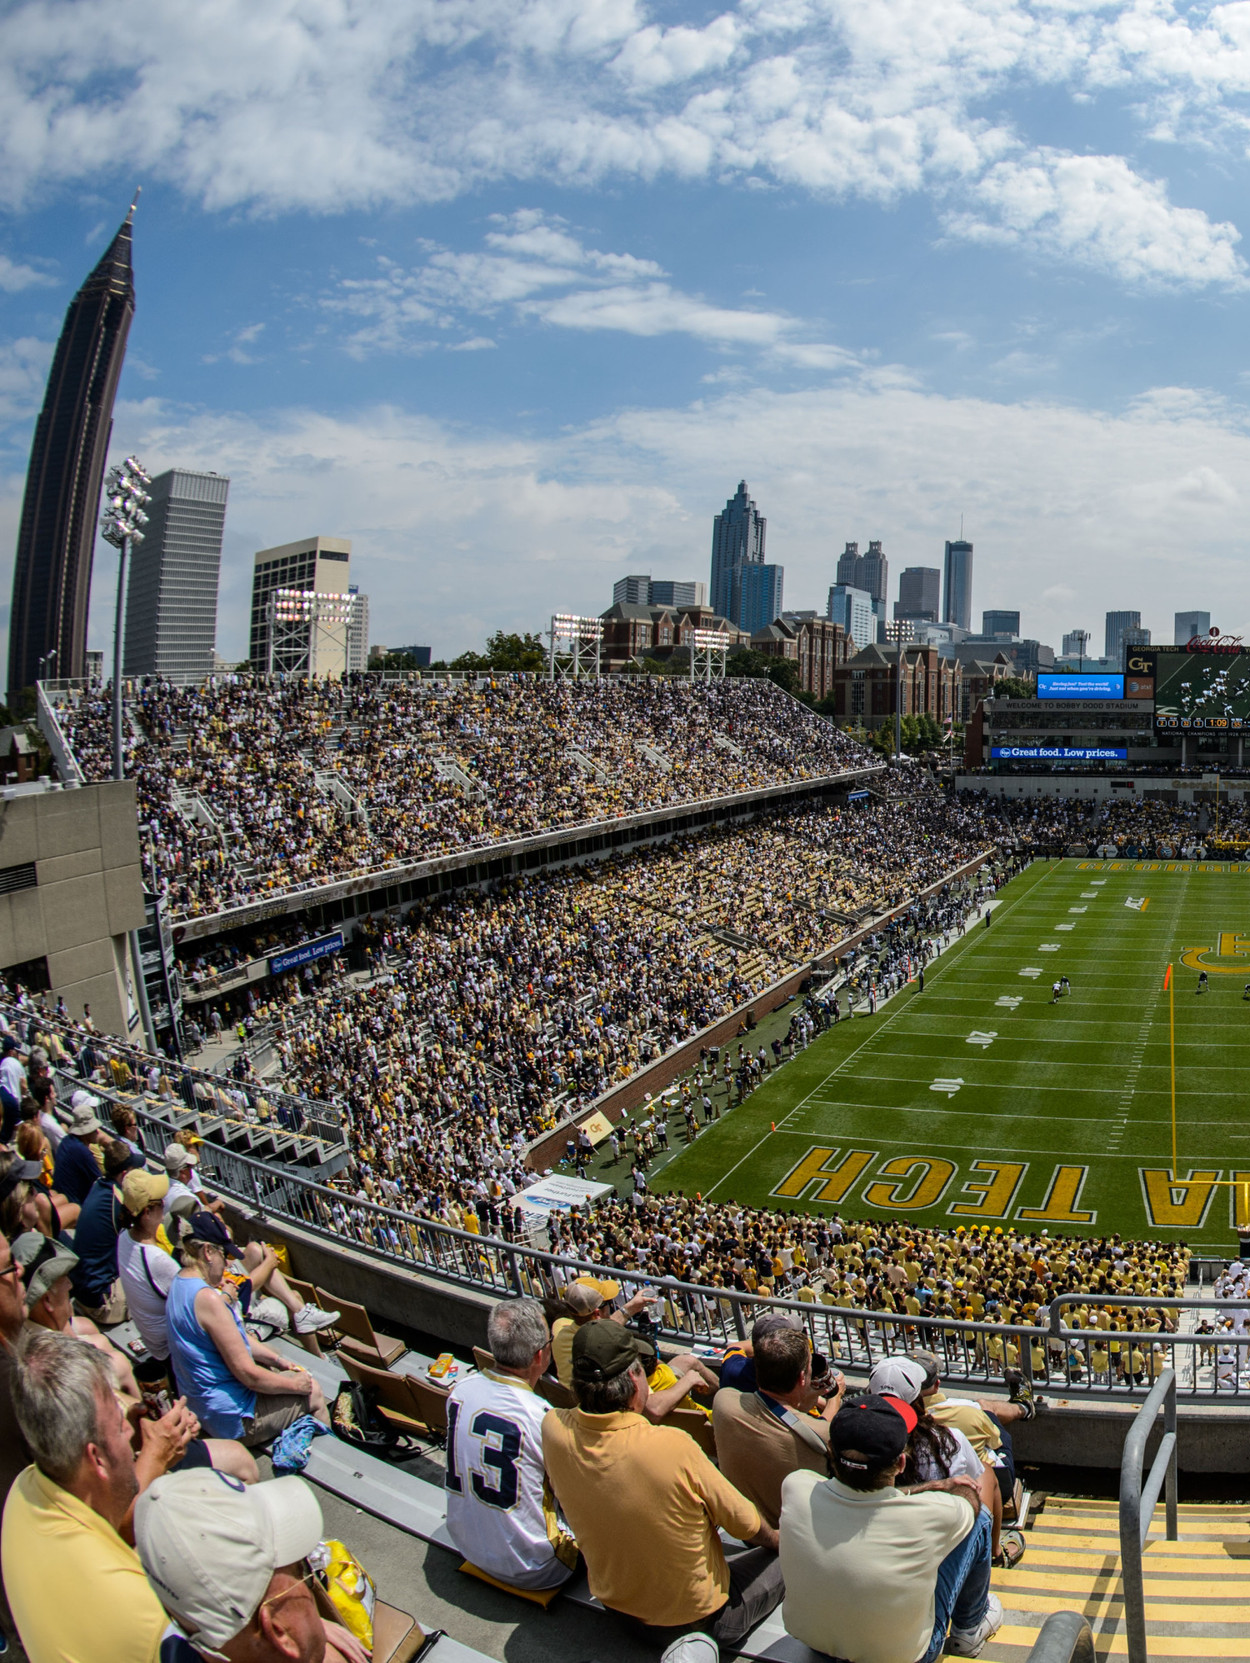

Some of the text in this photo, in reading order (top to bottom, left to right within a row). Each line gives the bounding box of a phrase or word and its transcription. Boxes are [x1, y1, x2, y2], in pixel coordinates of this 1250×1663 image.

[1186, 635, 1244, 654] Coca-Cola
[1128, 657, 1152, 673] GT
[1210, 719, 1227, 727] 1:09
[1011, 748, 1037, 756] Great
[1039, 748, 1062, 756] food.
[1064, 749, 1084, 757] Low
[1085, 749, 1118, 758] prices.
[1171, 780, 1250, 789] Georgia Tech
[282, 954, 299, 966] Great
[299, 950, 311, 961] food.
[311, 946, 324, 956] Low
[324, 940, 342, 953] prices.
[995, 995, 1023, 1007] 30
[965, 1030, 998, 1044] 20
[929, 1078, 964, 1092] 10
[769, 1145, 1097, 1224] TECH
[445, 1398, 526, 1514] 13
